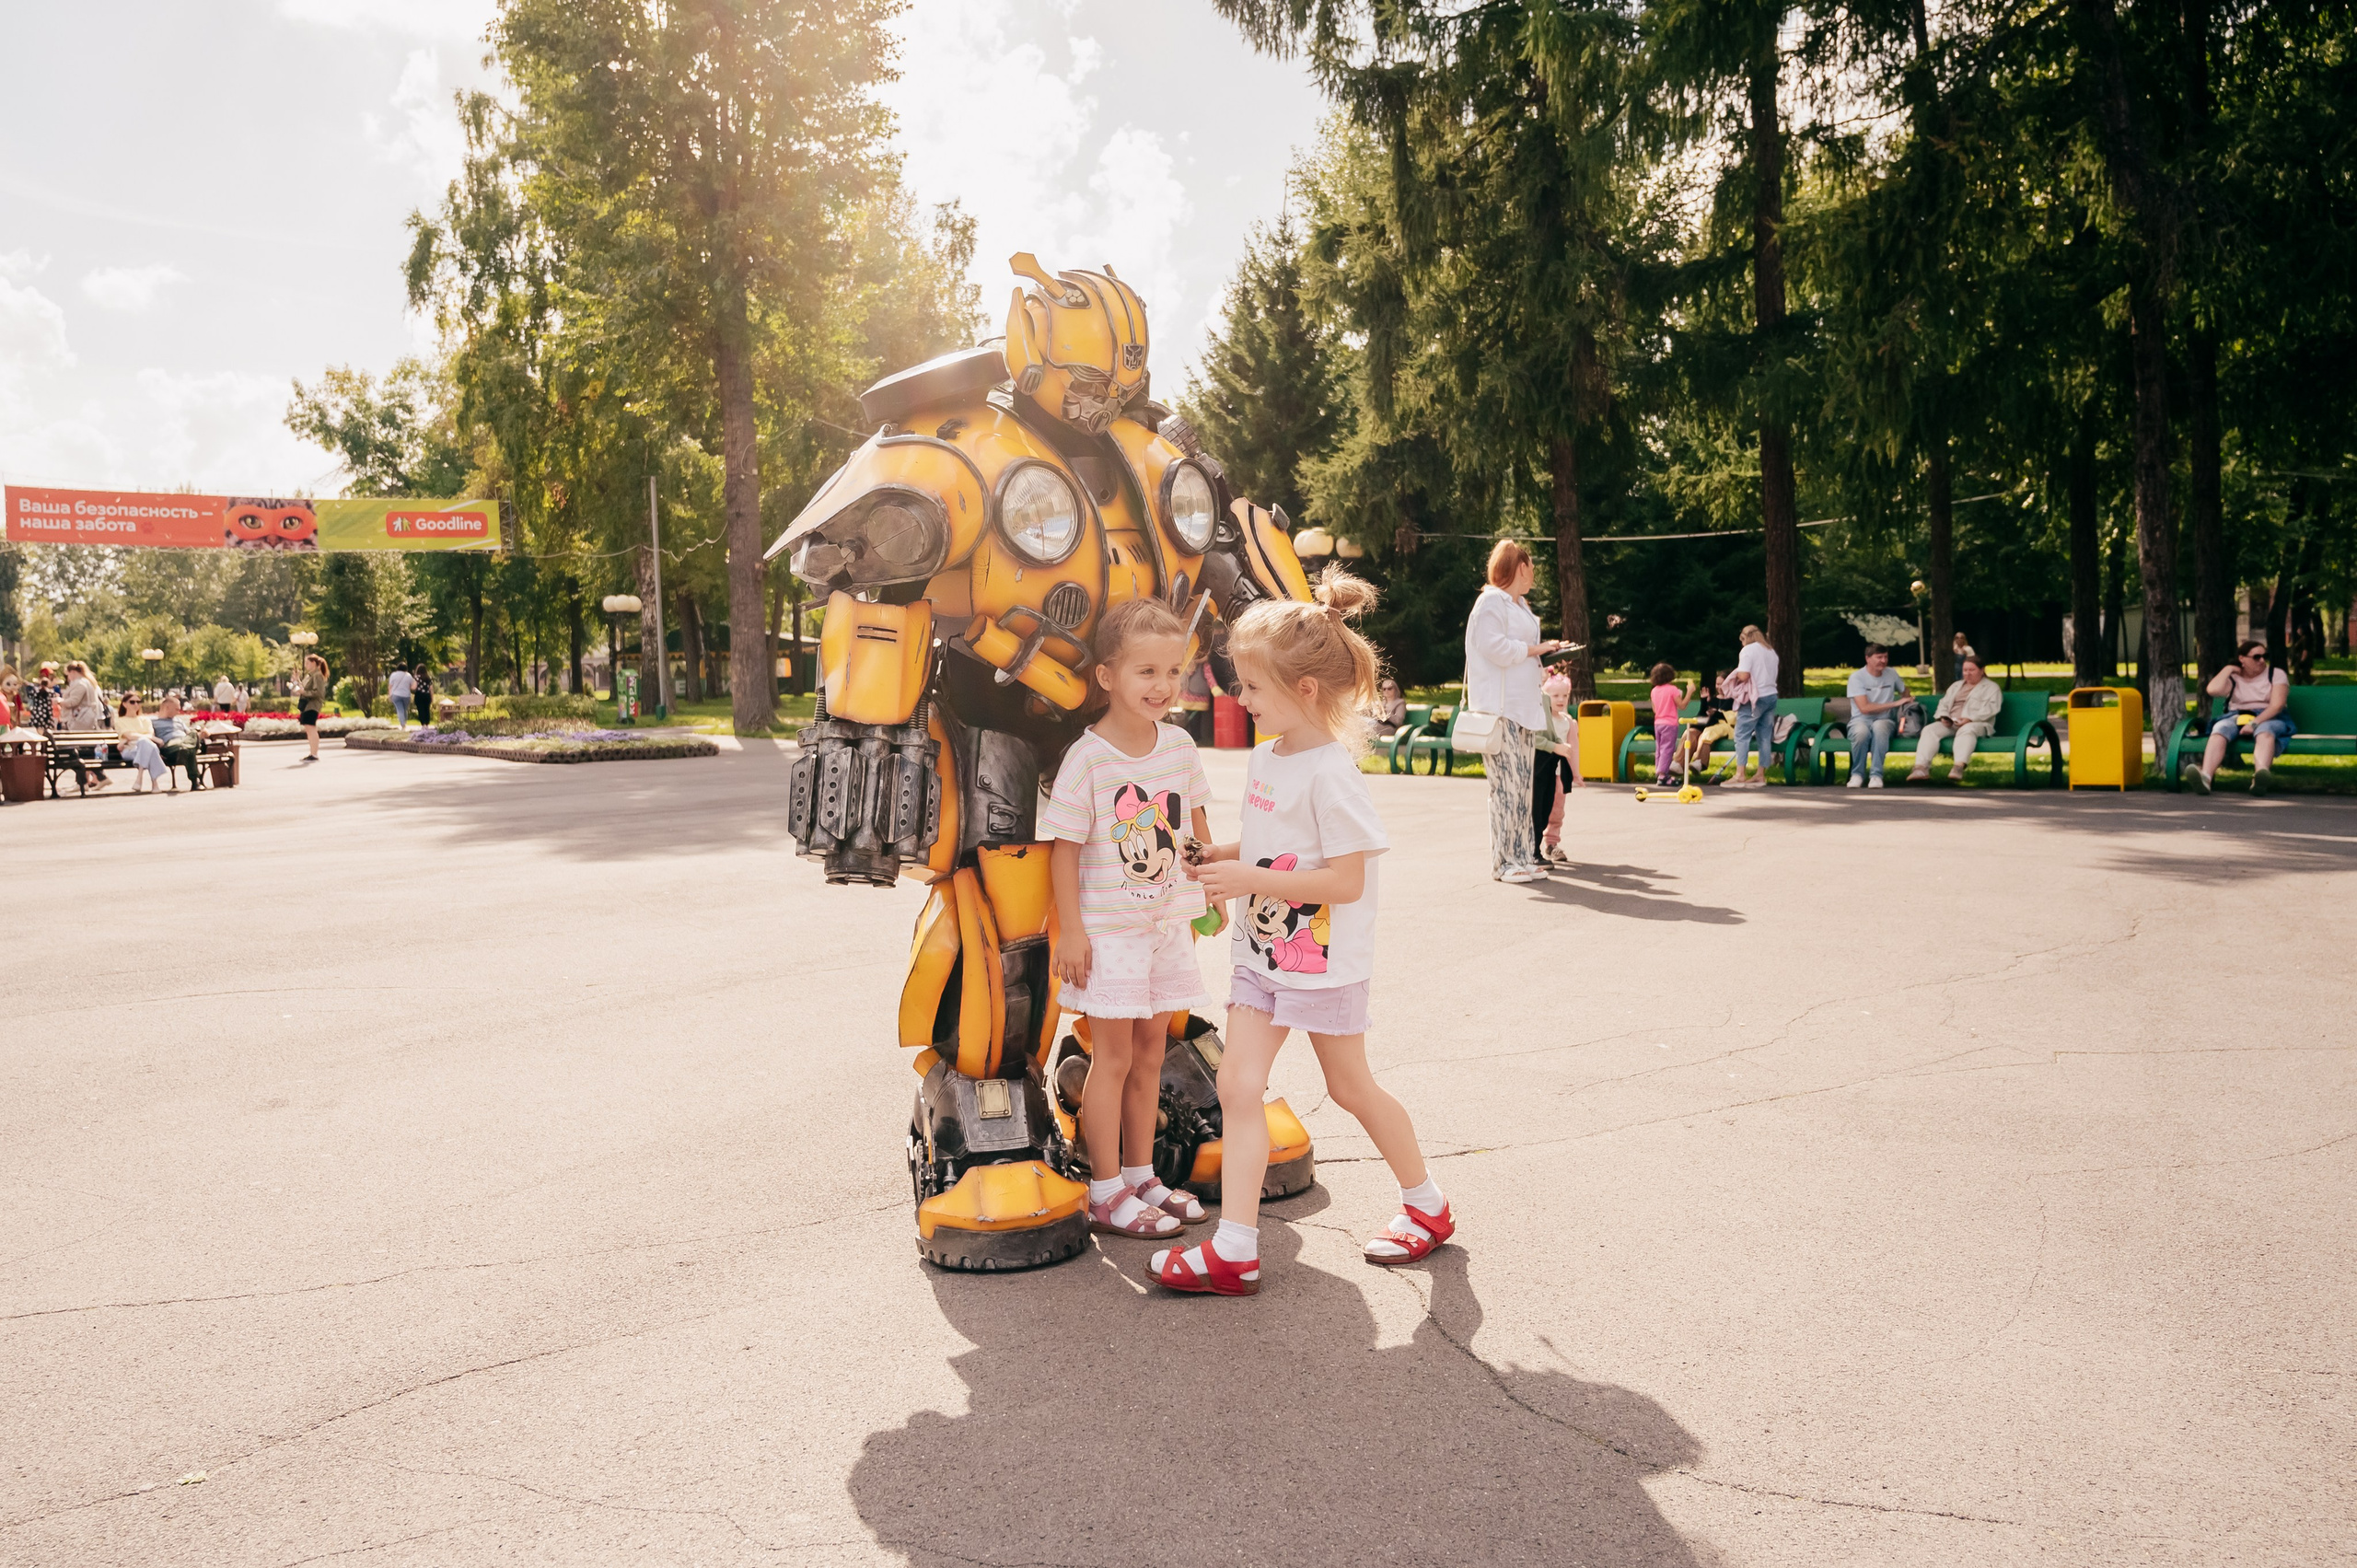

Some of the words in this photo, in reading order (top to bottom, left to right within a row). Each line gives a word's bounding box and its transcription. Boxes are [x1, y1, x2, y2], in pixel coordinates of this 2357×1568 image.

[18, 498, 71, 515] Ваша
[75, 500, 199, 519] безопасность
[19, 517, 71, 530] наша
[75, 517, 136, 532] забота
[415, 516, 482, 531] Goodline
